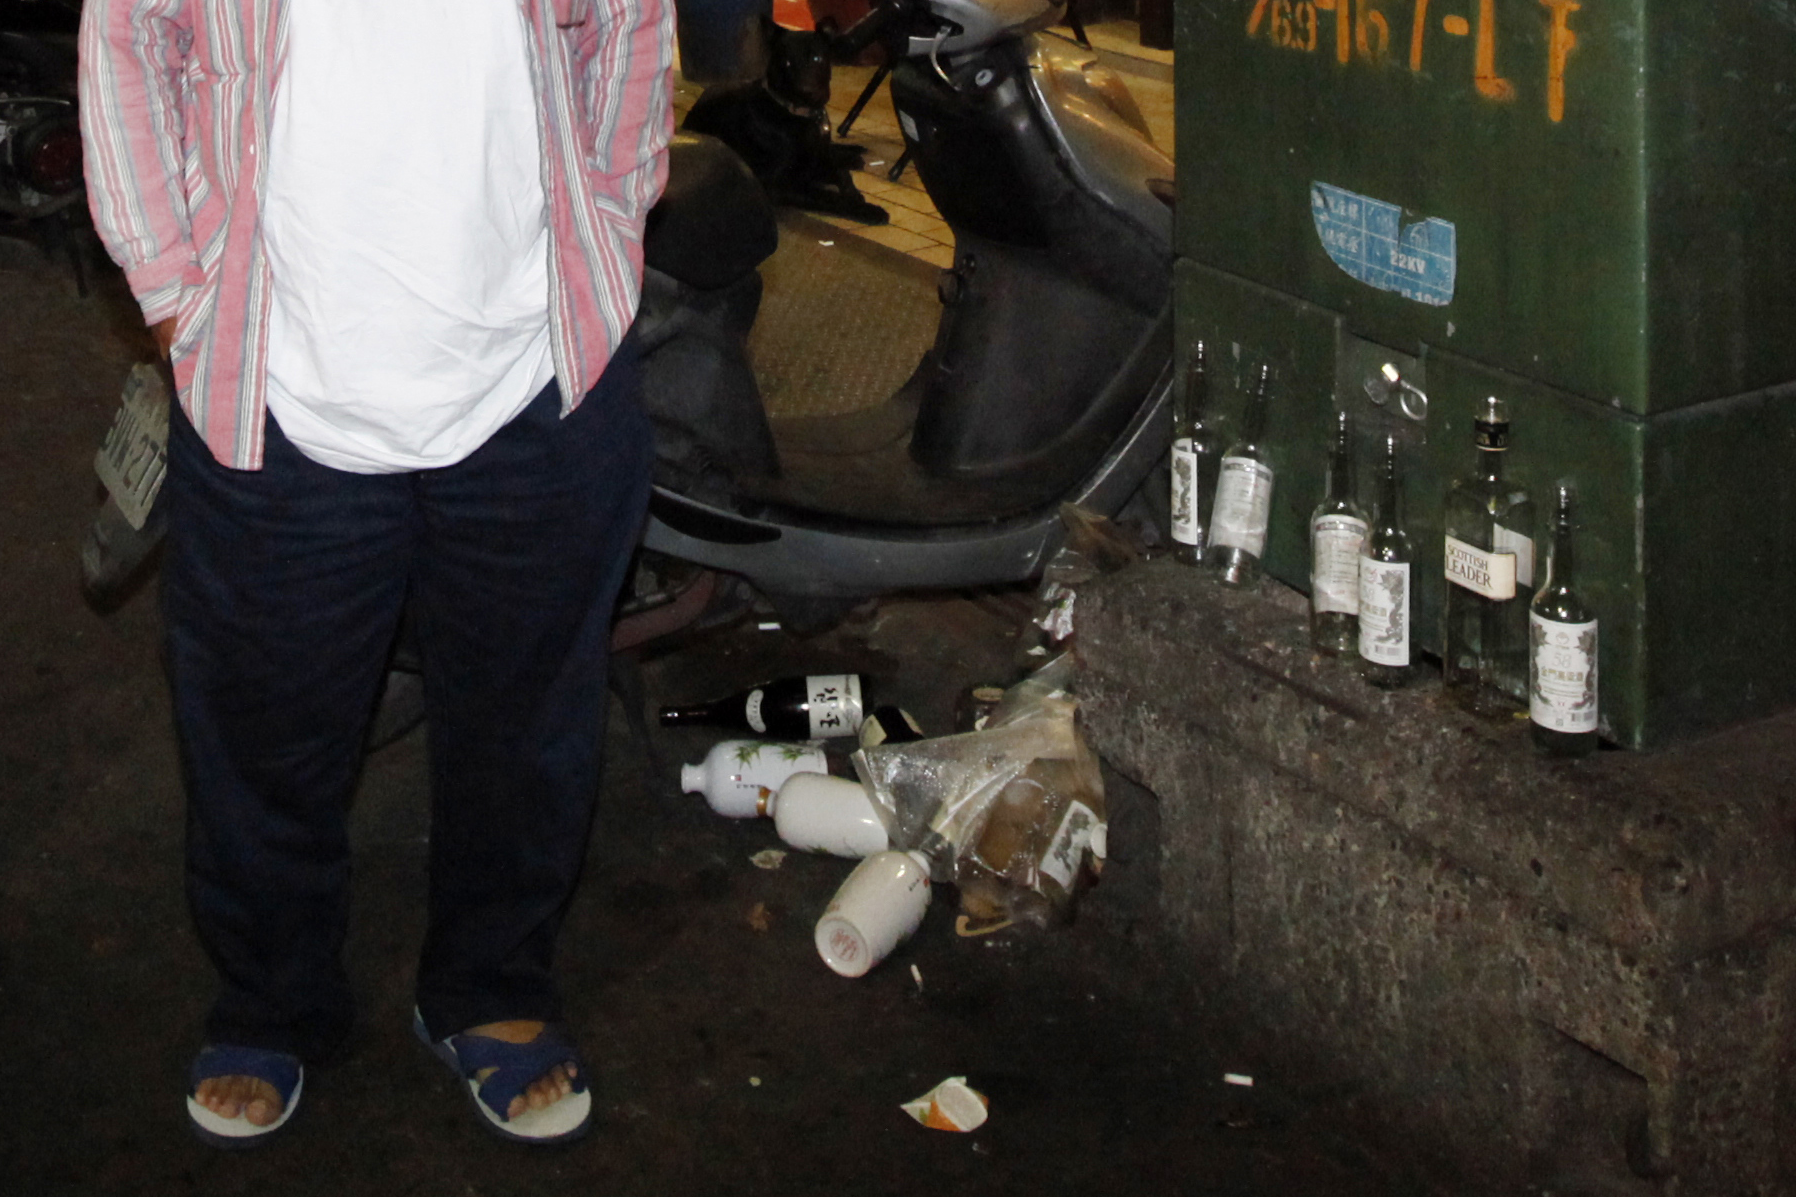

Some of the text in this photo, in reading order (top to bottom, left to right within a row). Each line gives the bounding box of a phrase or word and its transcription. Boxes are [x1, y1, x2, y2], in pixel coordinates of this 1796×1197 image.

[1389, 247, 1427, 276] 22KV
[1447, 543, 1489, 571] SCOTTISH
[1445, 555, 1493, 590] LEADER
[1552, 652, 1573, 669] 58
